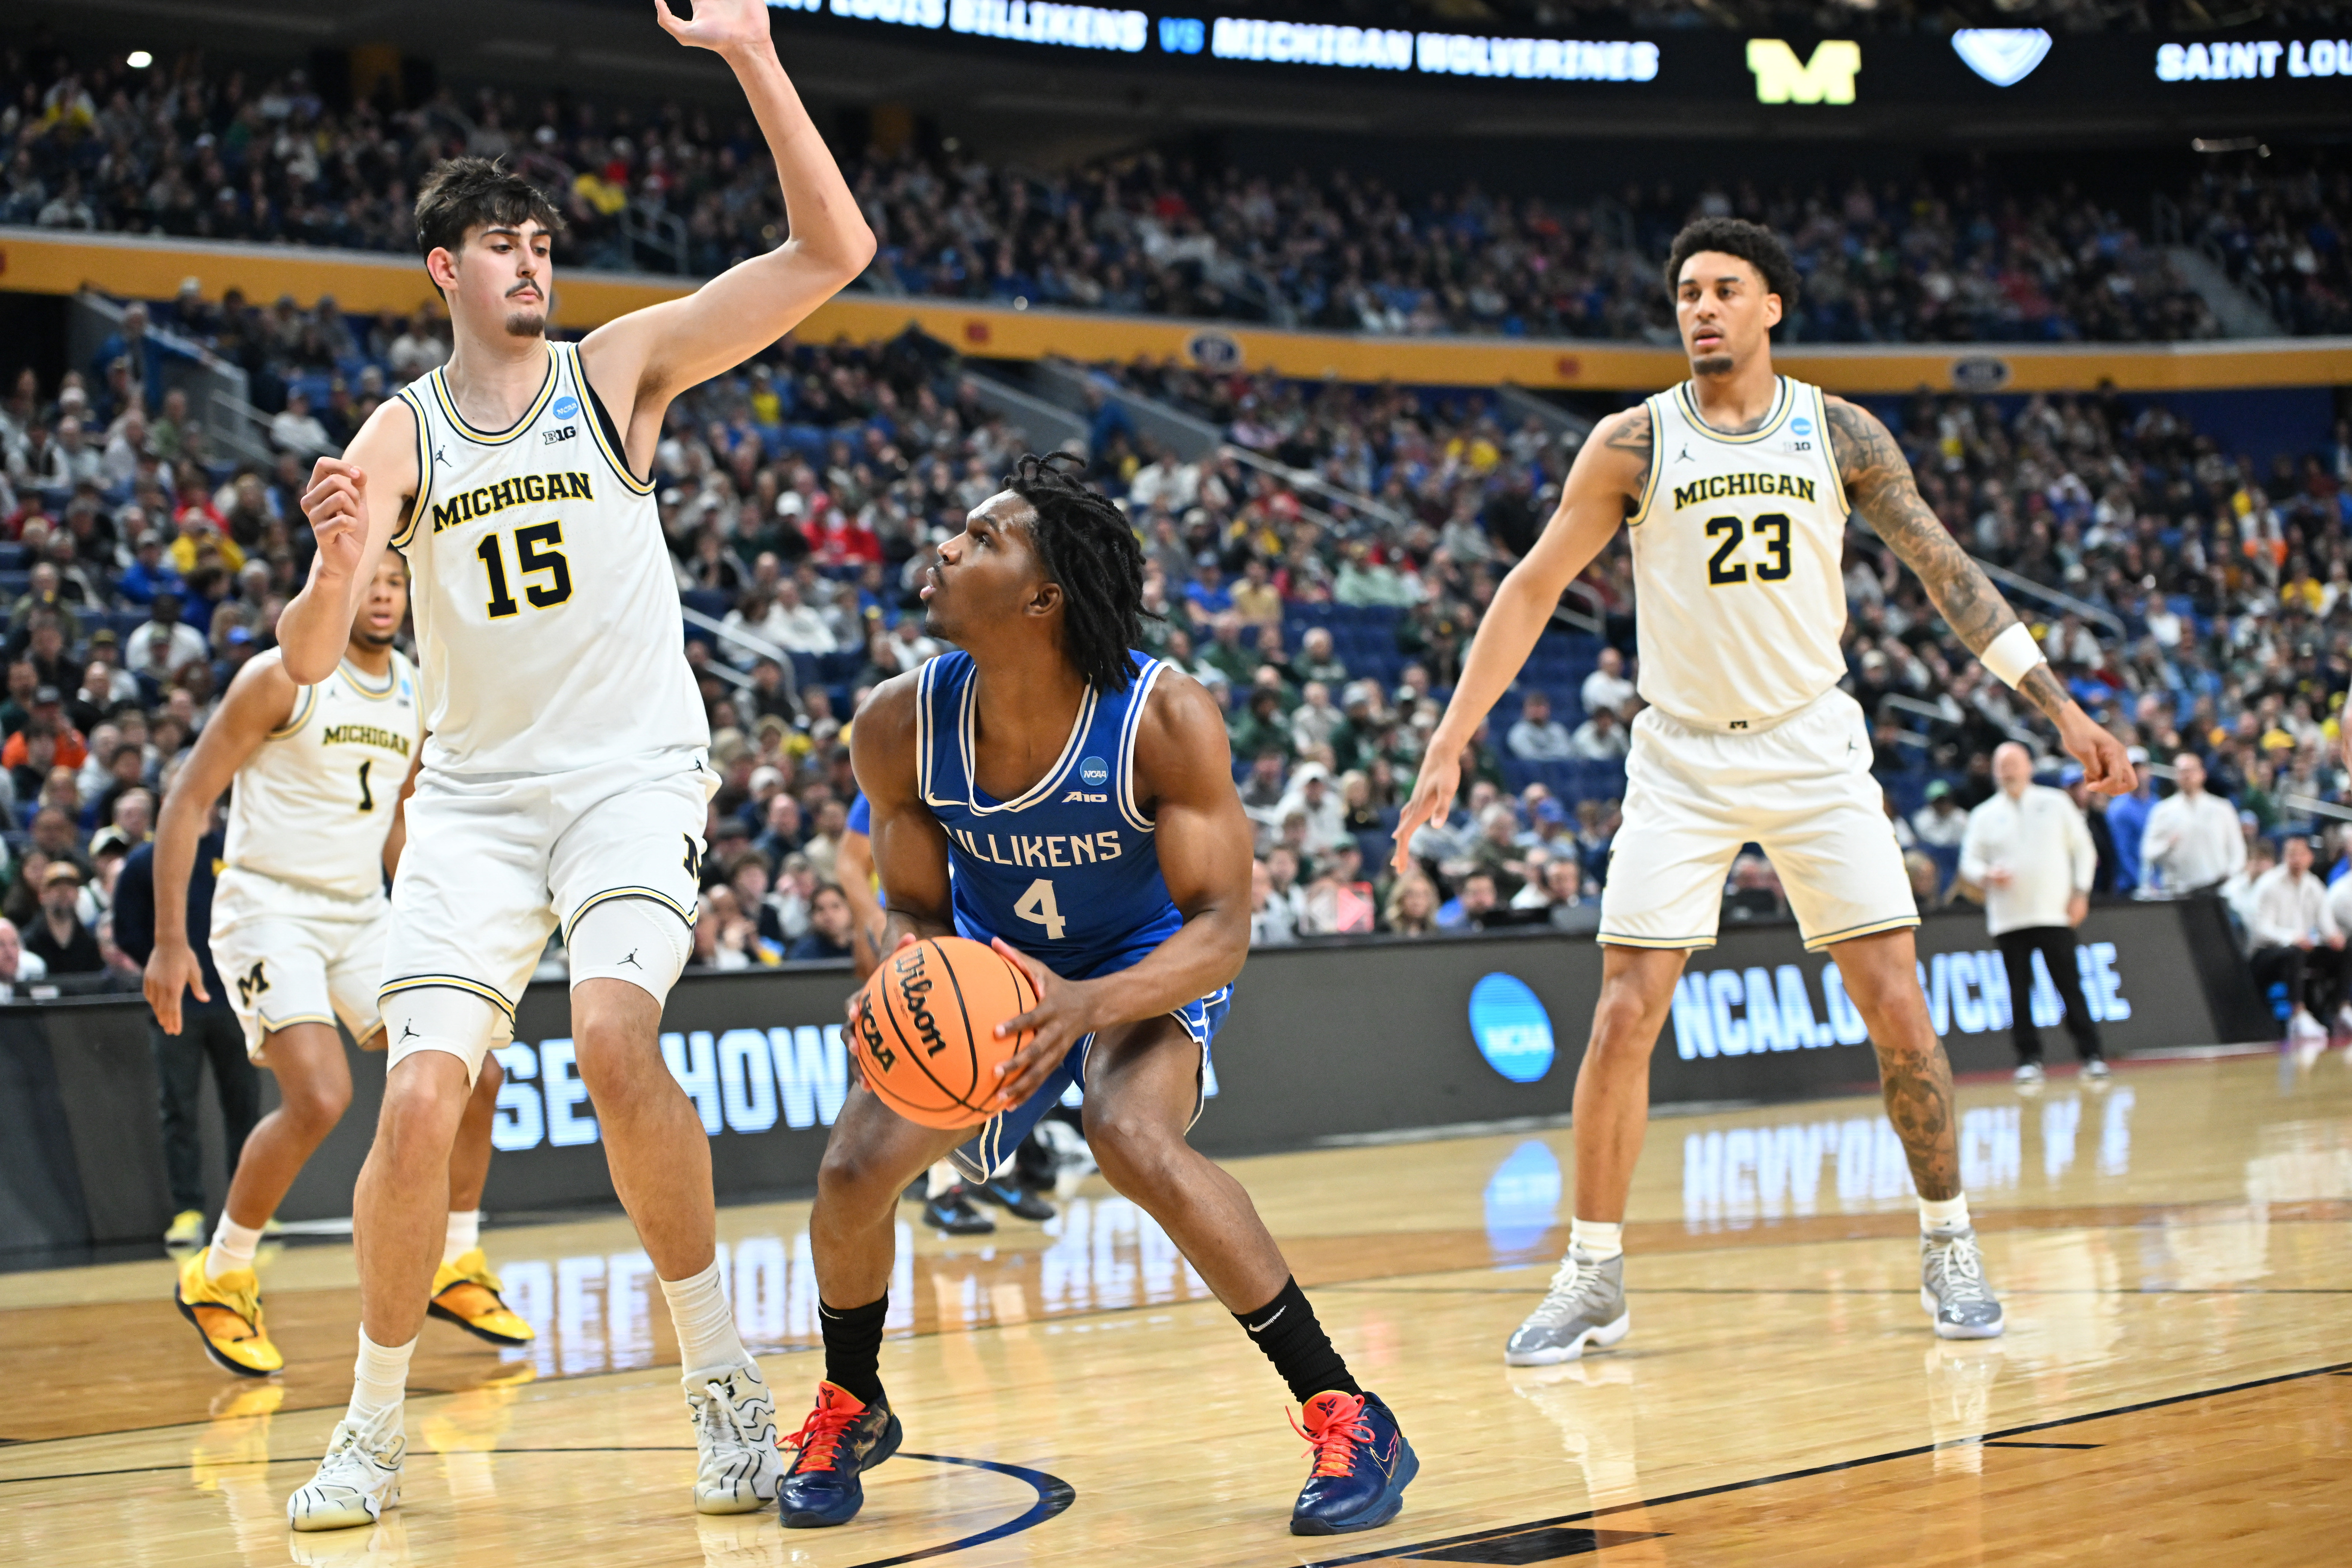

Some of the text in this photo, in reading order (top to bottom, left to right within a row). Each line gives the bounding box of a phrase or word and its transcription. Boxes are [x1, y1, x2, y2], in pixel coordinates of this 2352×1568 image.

[1158, 17, 1205, 54] VS
[1212, 16, 1413, 71] MICHIGAN
[1416, 32, 1659, 81] WOLVERINES
[1746, 39, 1861, 104] M
[2155, 40, 2283, 81] SAINT
[557, 403, 577, 415] NCAA
[432, 472, 595, 535] MICHIGAN
[1673, 472, 1816, 511] MICHIGAN
[476, 519, 573, 621] 15
[1705, 513, 1792, 588] 23
[322, 724, 411, 758] MICHIGAN
[358, 758, 374, 814] 1
[938, 821, 1121, 867] ILLIKENS
[1013, 879, 1065, 939] 4
[237, 959, 270, 1009] M
[894, 946, 946, 1060] Wilson
